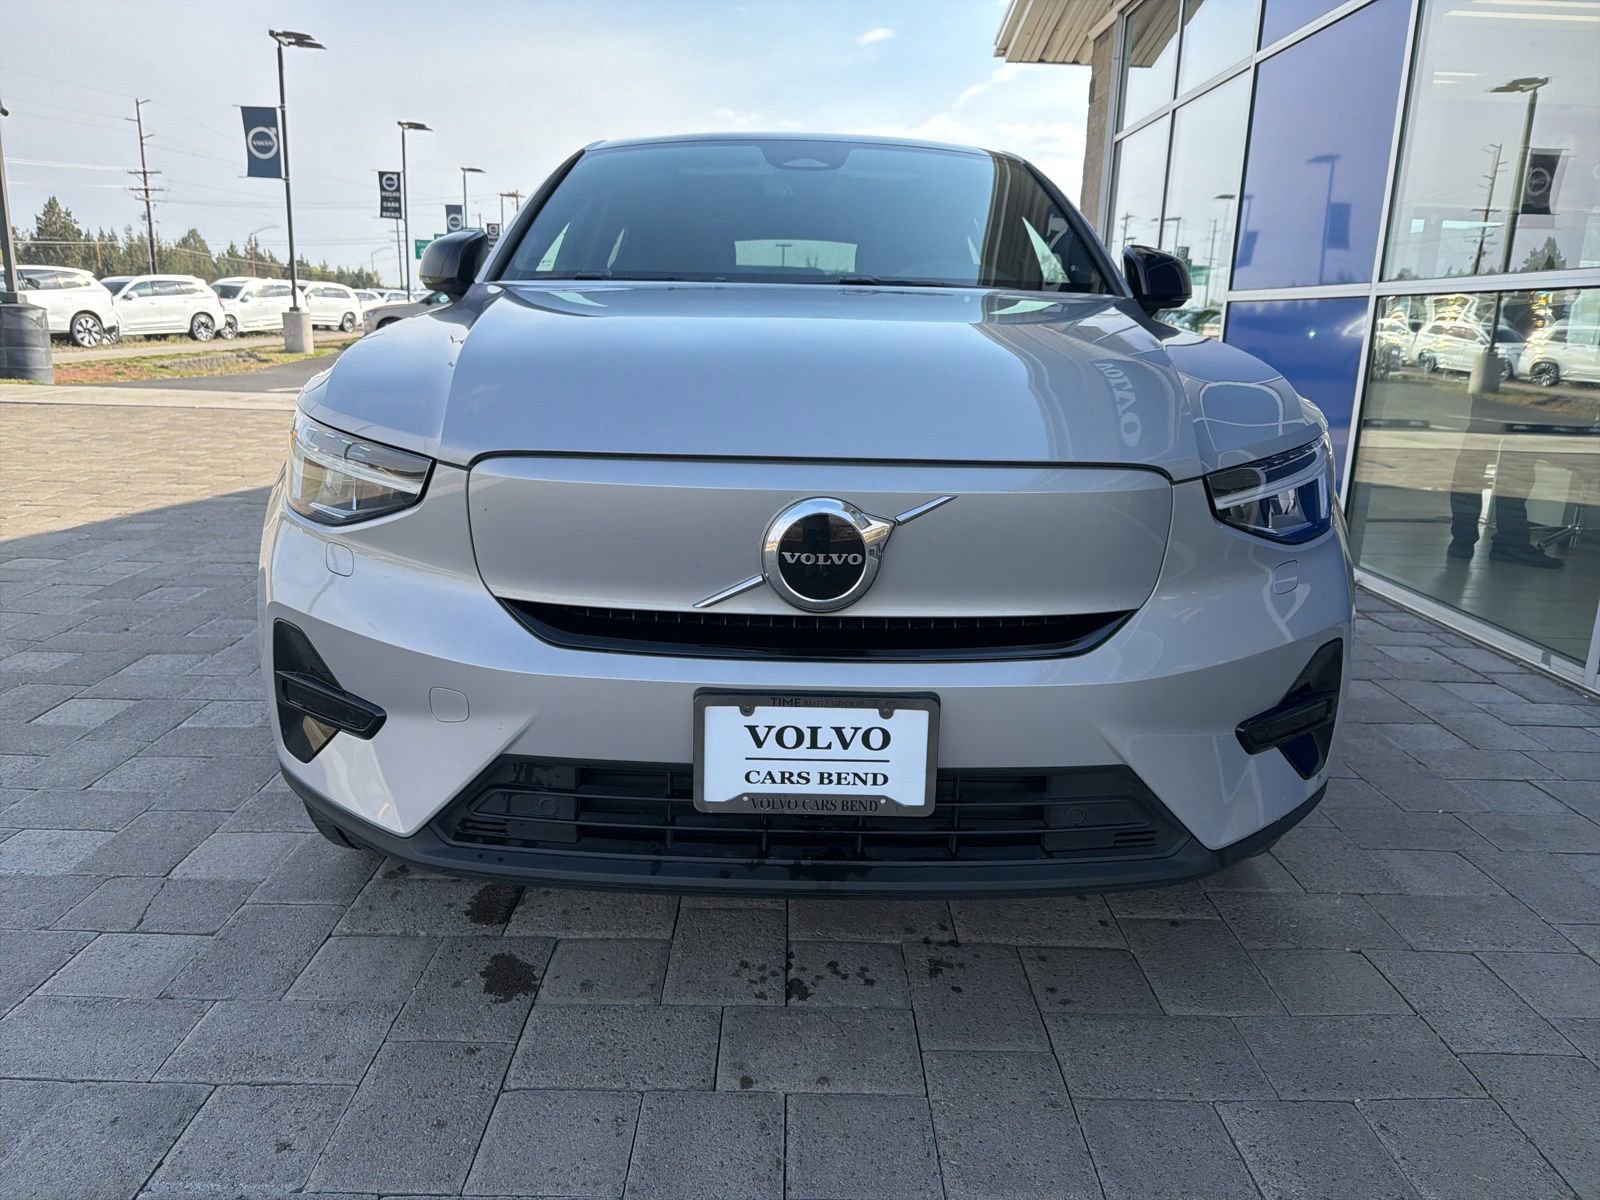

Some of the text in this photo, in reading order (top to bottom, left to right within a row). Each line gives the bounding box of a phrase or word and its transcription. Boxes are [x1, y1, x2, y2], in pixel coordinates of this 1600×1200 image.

[781, 551, 863, 565] VOLVO
[770, 697, 865, 708] TIME AUTO GROUP
[743, 724, 892, 751] VOLVO
[744, 770, 889, 787] CARS BEND
[750, 797, 878, 813] VOLVO CARS BEND
